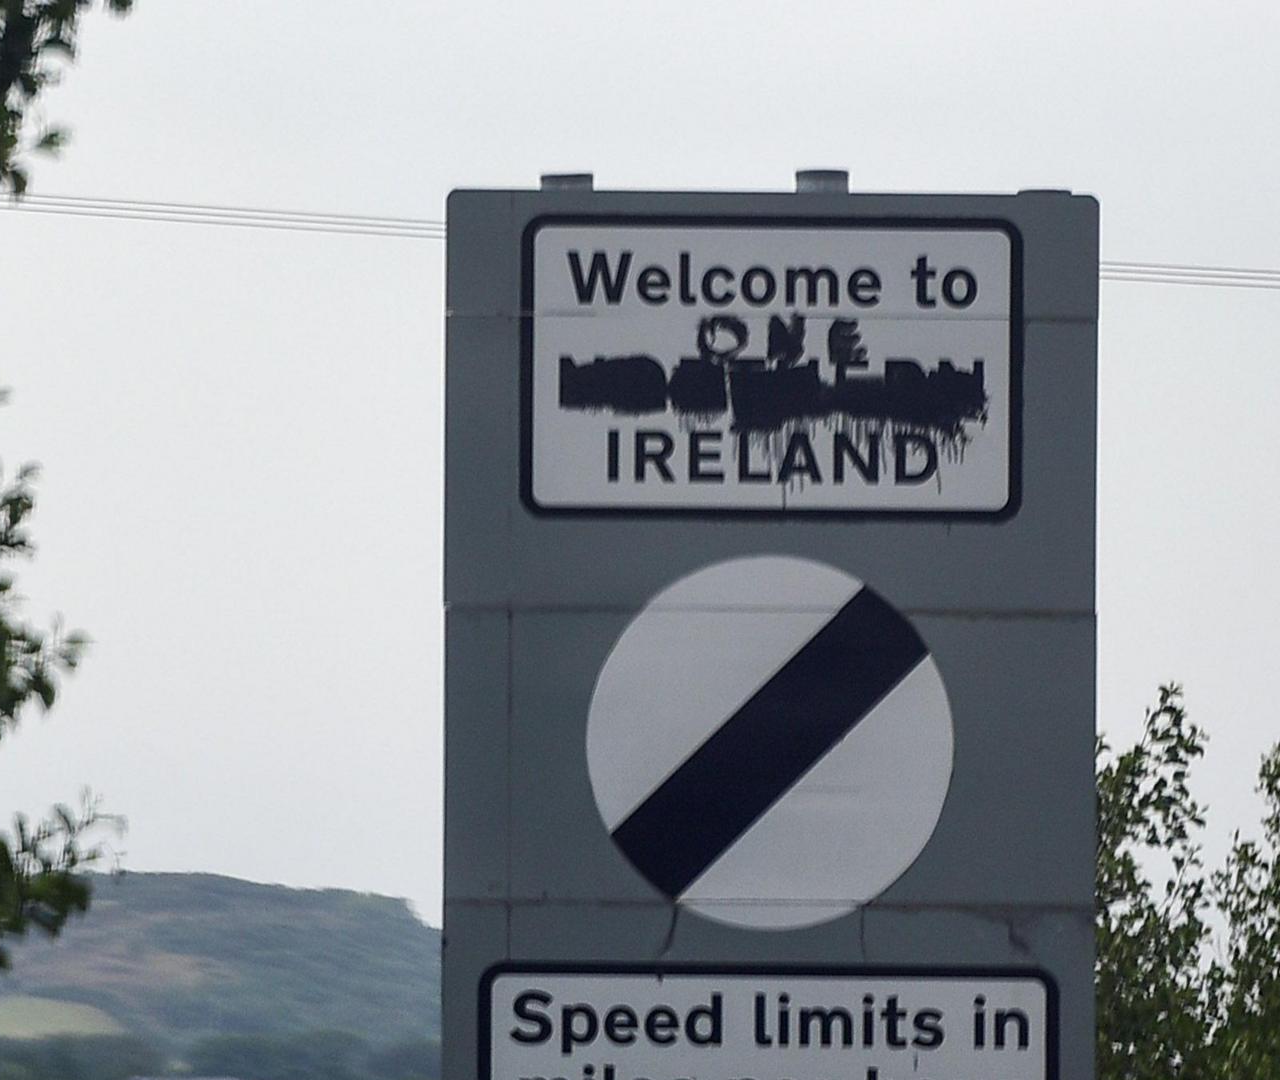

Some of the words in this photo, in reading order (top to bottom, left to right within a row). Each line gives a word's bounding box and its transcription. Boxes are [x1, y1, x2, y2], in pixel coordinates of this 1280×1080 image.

[567, 251, 882, 307] Welcome
[911, 255, 978, 308] to
[697, 313, 867, 366] ONE
[607, 430, 939, 485] IRELAND
[509, 990, 723, 1054] Speed
[754, 992, 944, 1050] limits
[974, 994, 1030, 1050] in
